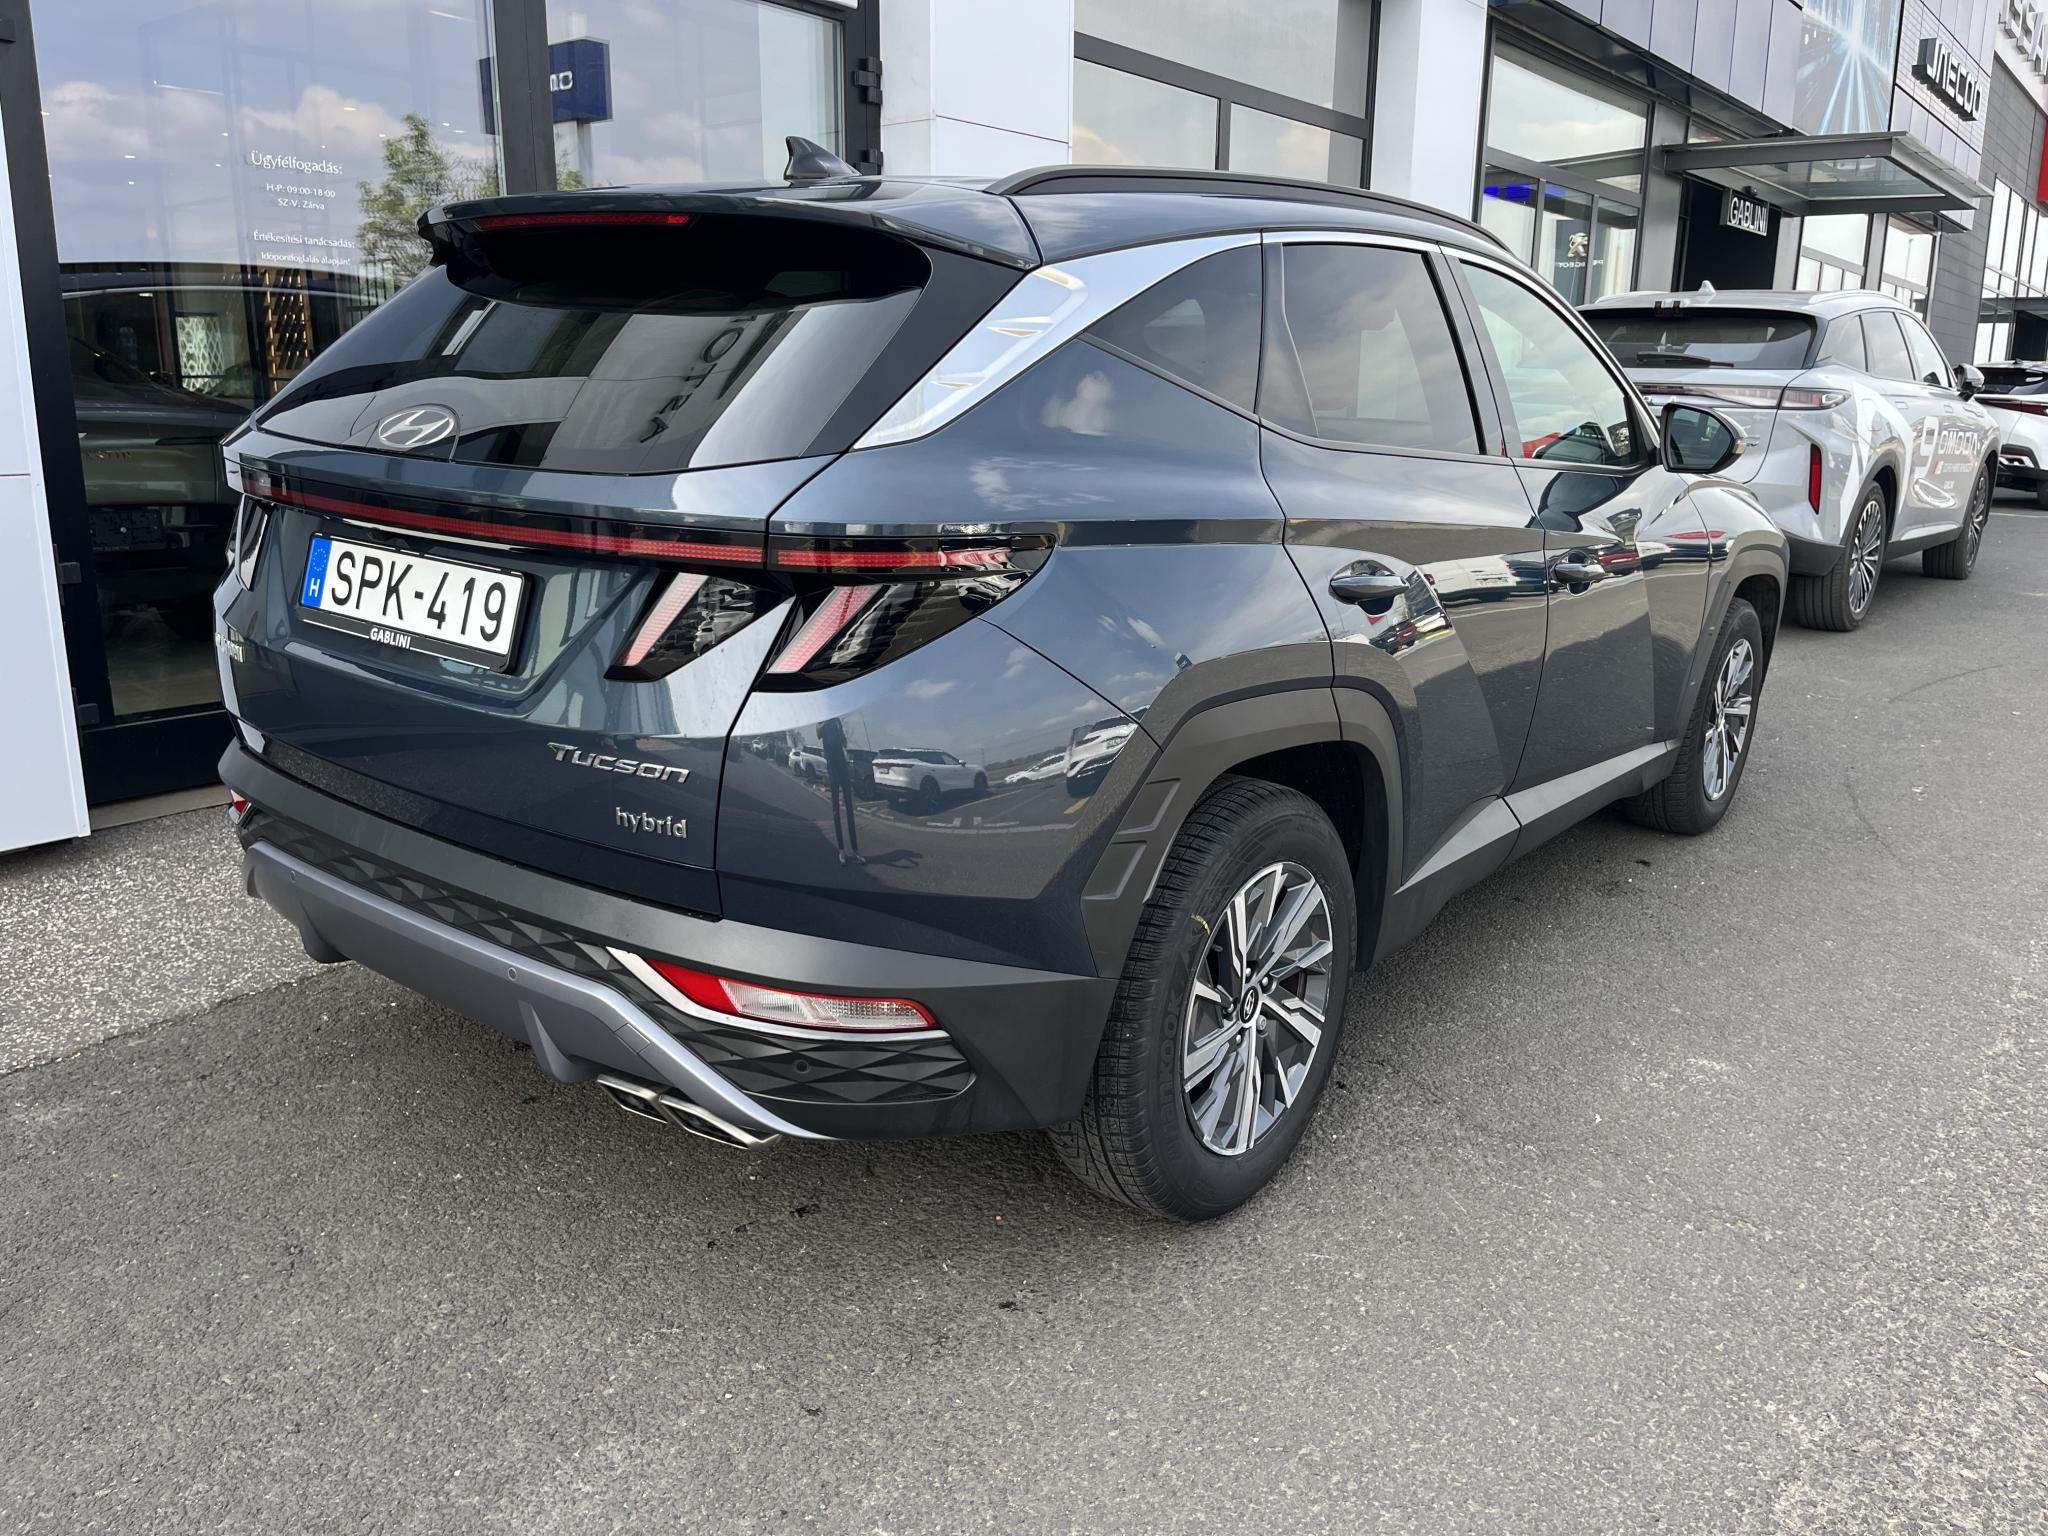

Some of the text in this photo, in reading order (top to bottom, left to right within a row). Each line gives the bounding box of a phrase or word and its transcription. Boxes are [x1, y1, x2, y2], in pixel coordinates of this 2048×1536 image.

[1924, 39, 1983, 121] JAECOO
[251, 150, 343, 175] Ügyfélfogadás:
[303, 200, 325, 211] Zárva
[1730, 197, 1767, 233] GABLINI
[254, 229, 355, 249] Értékesítési tanácsadás:
[1938, 430, 1978, 455] OMODA
[309, 551, 506, 642] H SPK-419
[370, 627, 411, 649] GABLINI
[615, 807, 687, 838] hybrid
